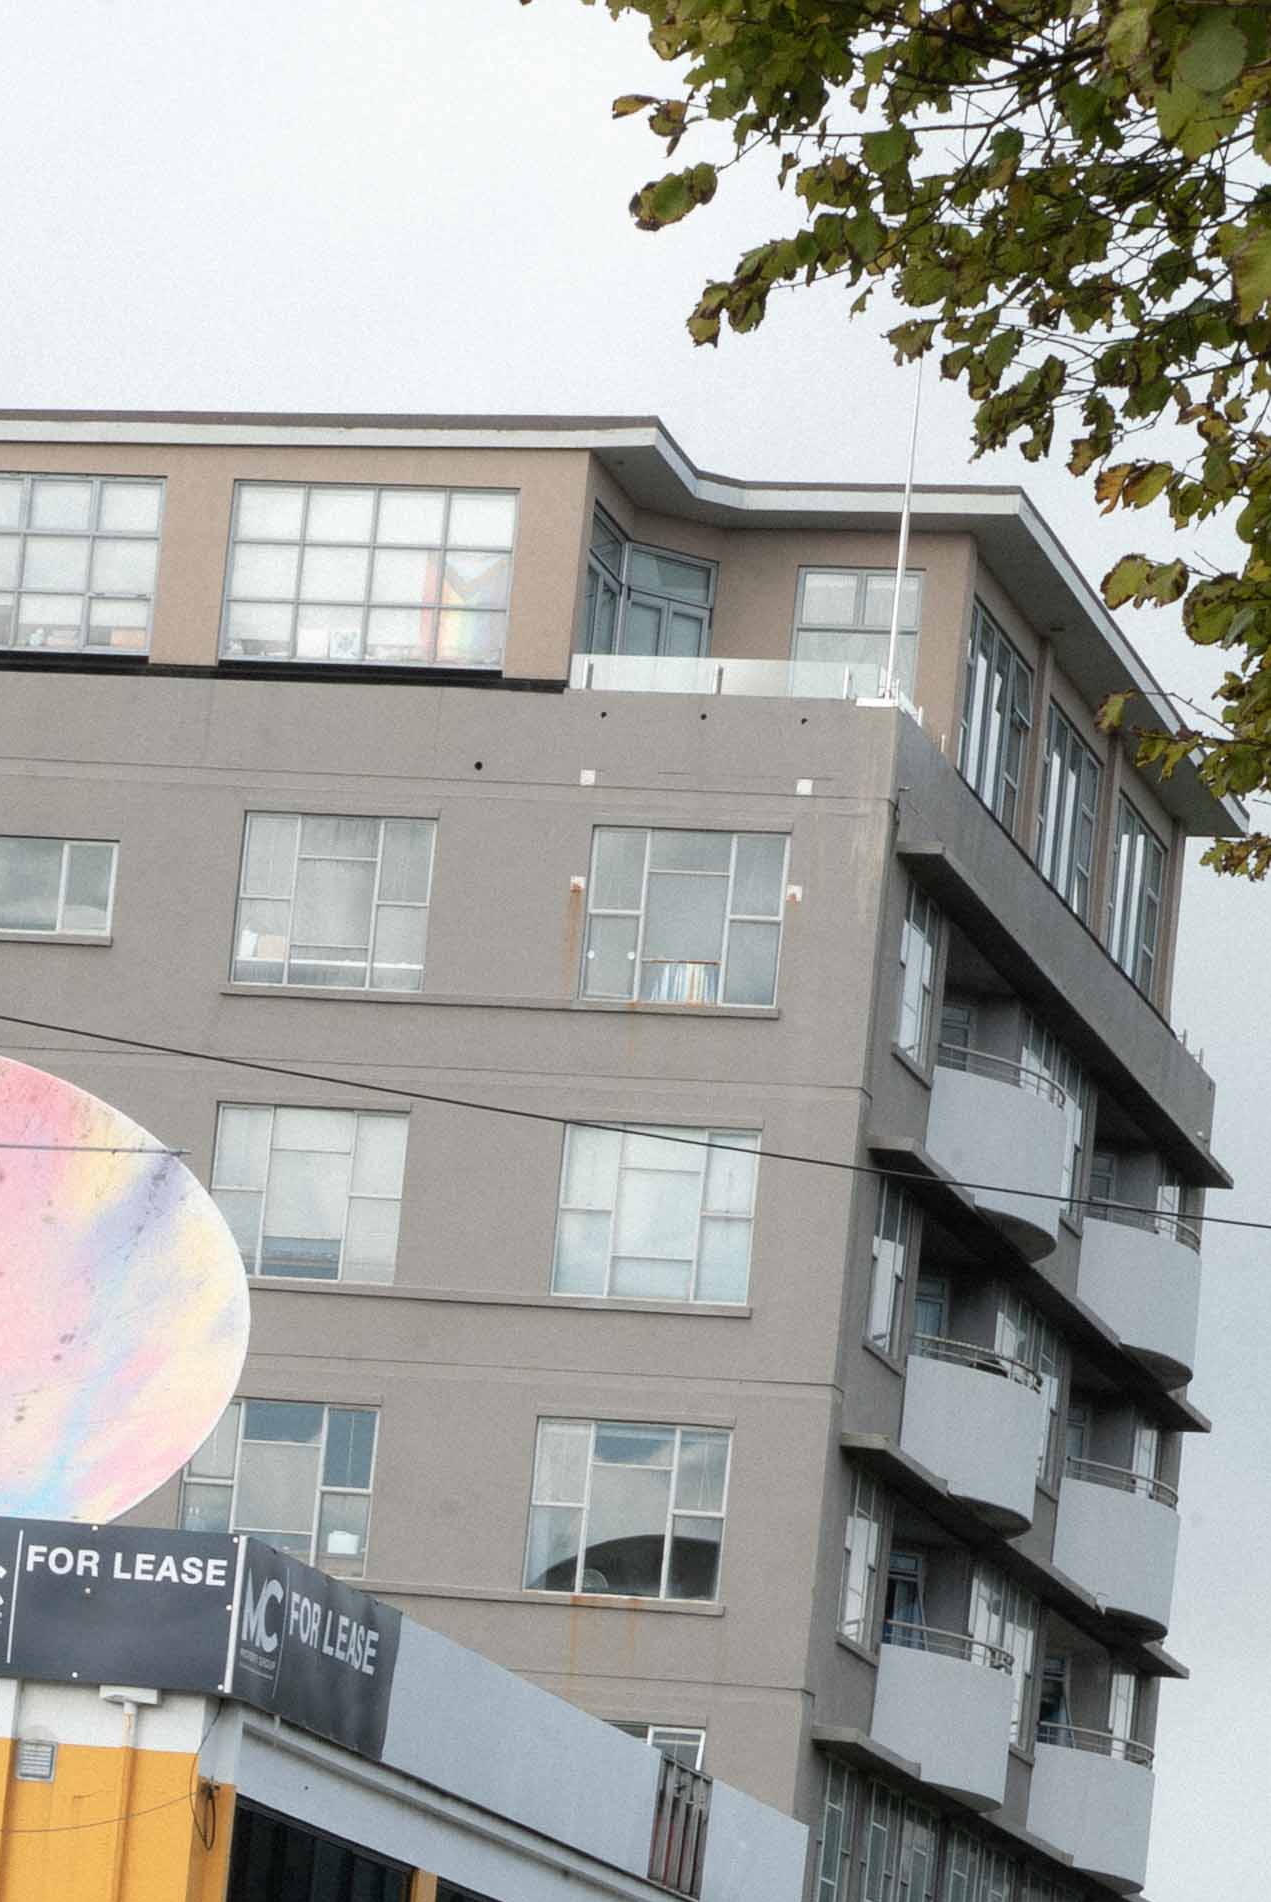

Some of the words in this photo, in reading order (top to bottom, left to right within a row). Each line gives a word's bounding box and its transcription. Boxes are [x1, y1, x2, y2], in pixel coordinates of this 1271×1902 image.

[26, 1545, 101, 1578] FOR
[113, 1551, 229, 1587] LEASE
[241, 1567, 284, 1654] MC
[289, 1591, 322, 1650] FOR
[322, 1609, 380, 1677] LEASE
